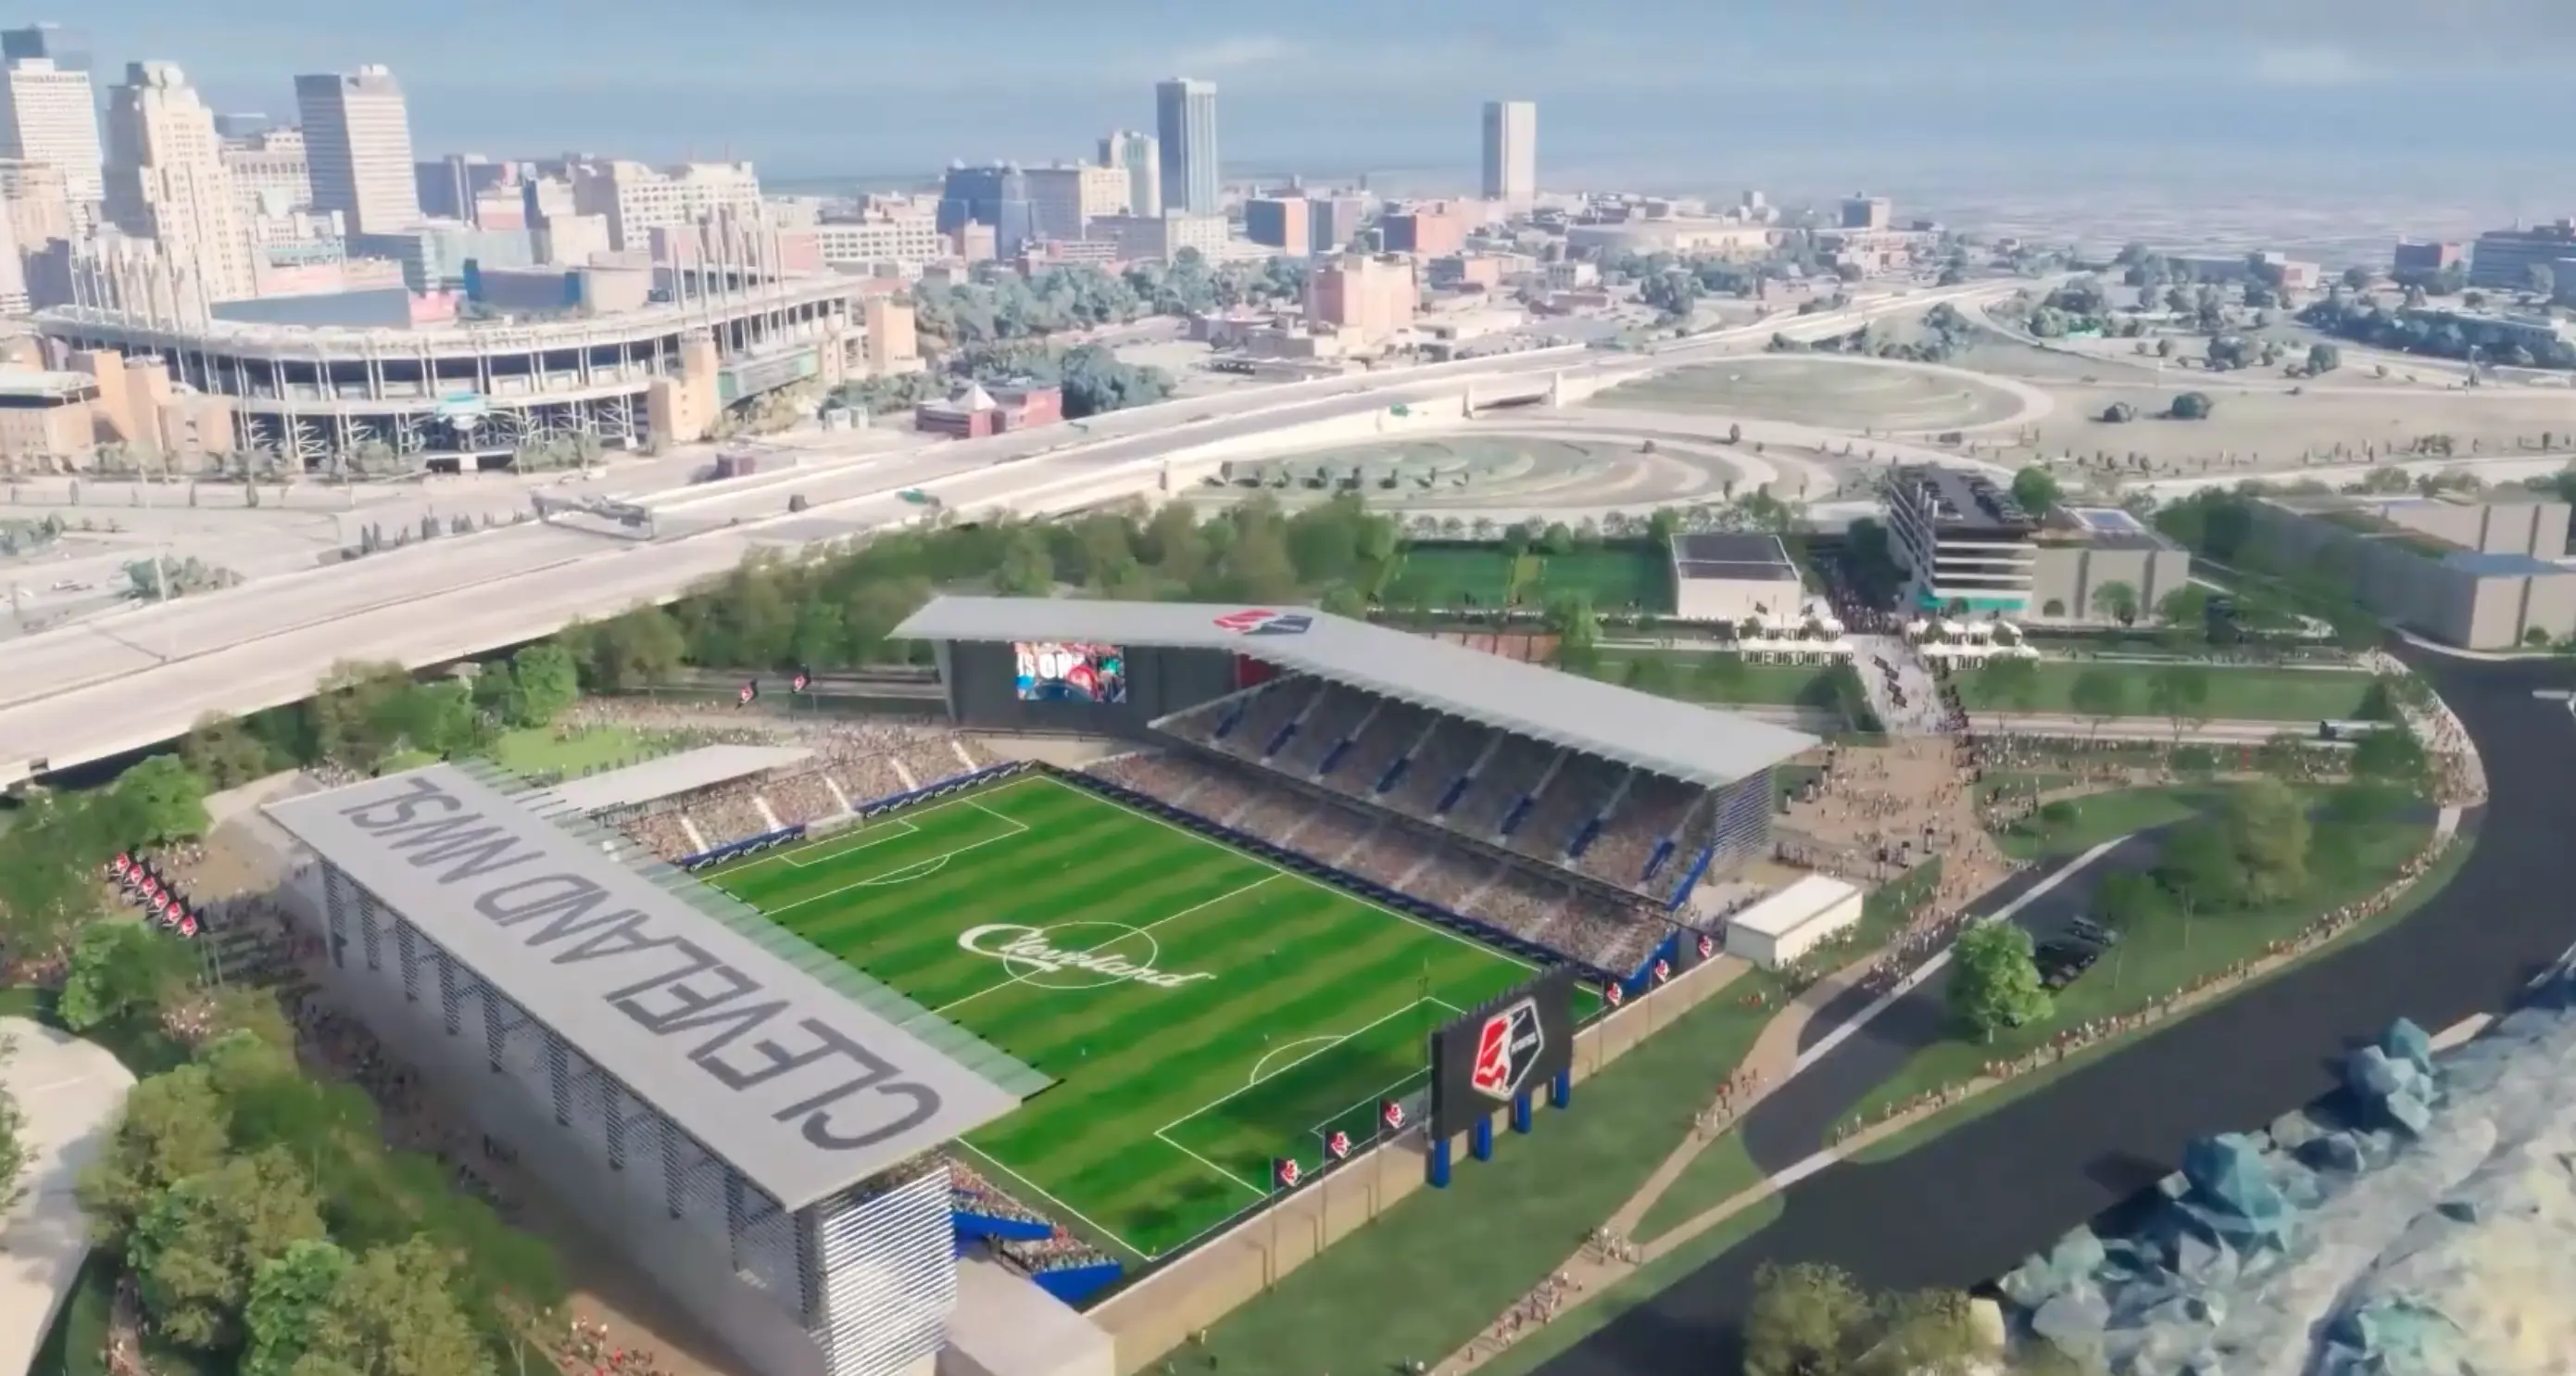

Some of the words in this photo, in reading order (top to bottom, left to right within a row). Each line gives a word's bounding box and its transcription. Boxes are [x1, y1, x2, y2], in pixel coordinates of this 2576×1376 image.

[339, 776, 545, 884] NWSL
[958, 923, 1217, 988] Cleveland
[473, 873, 941, 1151] CLEVELAND
